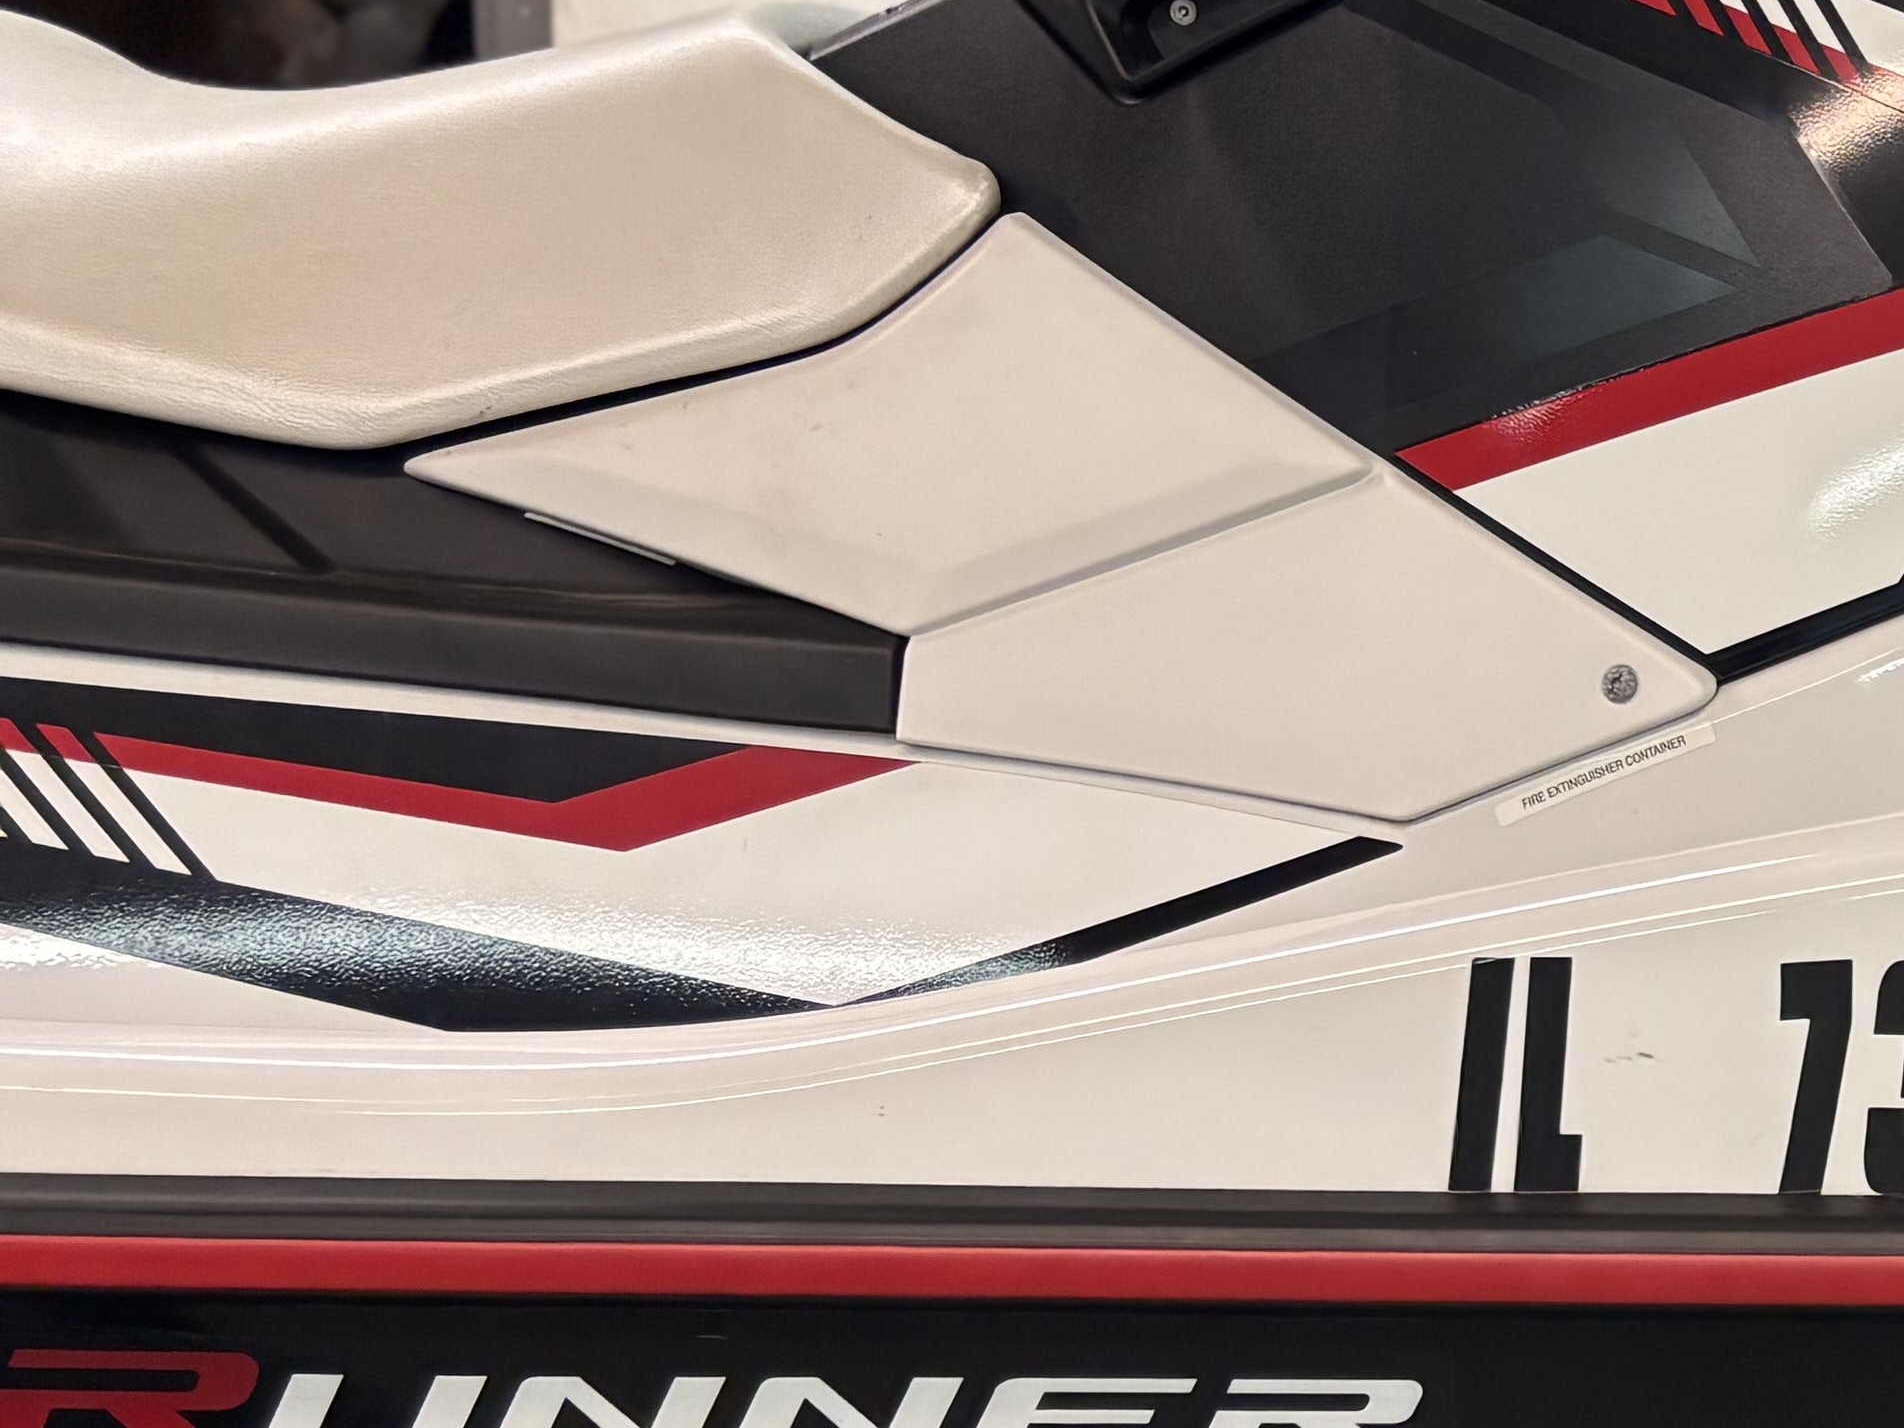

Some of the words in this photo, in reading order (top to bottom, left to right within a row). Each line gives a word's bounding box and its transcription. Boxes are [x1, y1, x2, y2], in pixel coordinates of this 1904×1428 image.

[1521, 792, 1546, 810] FIRE
[1546, 759, 1624, 798] EXTINGUISHER
[1625, 734, 1687, 766] CONTAINER
[1448, 957, 1583, 1193] IL
